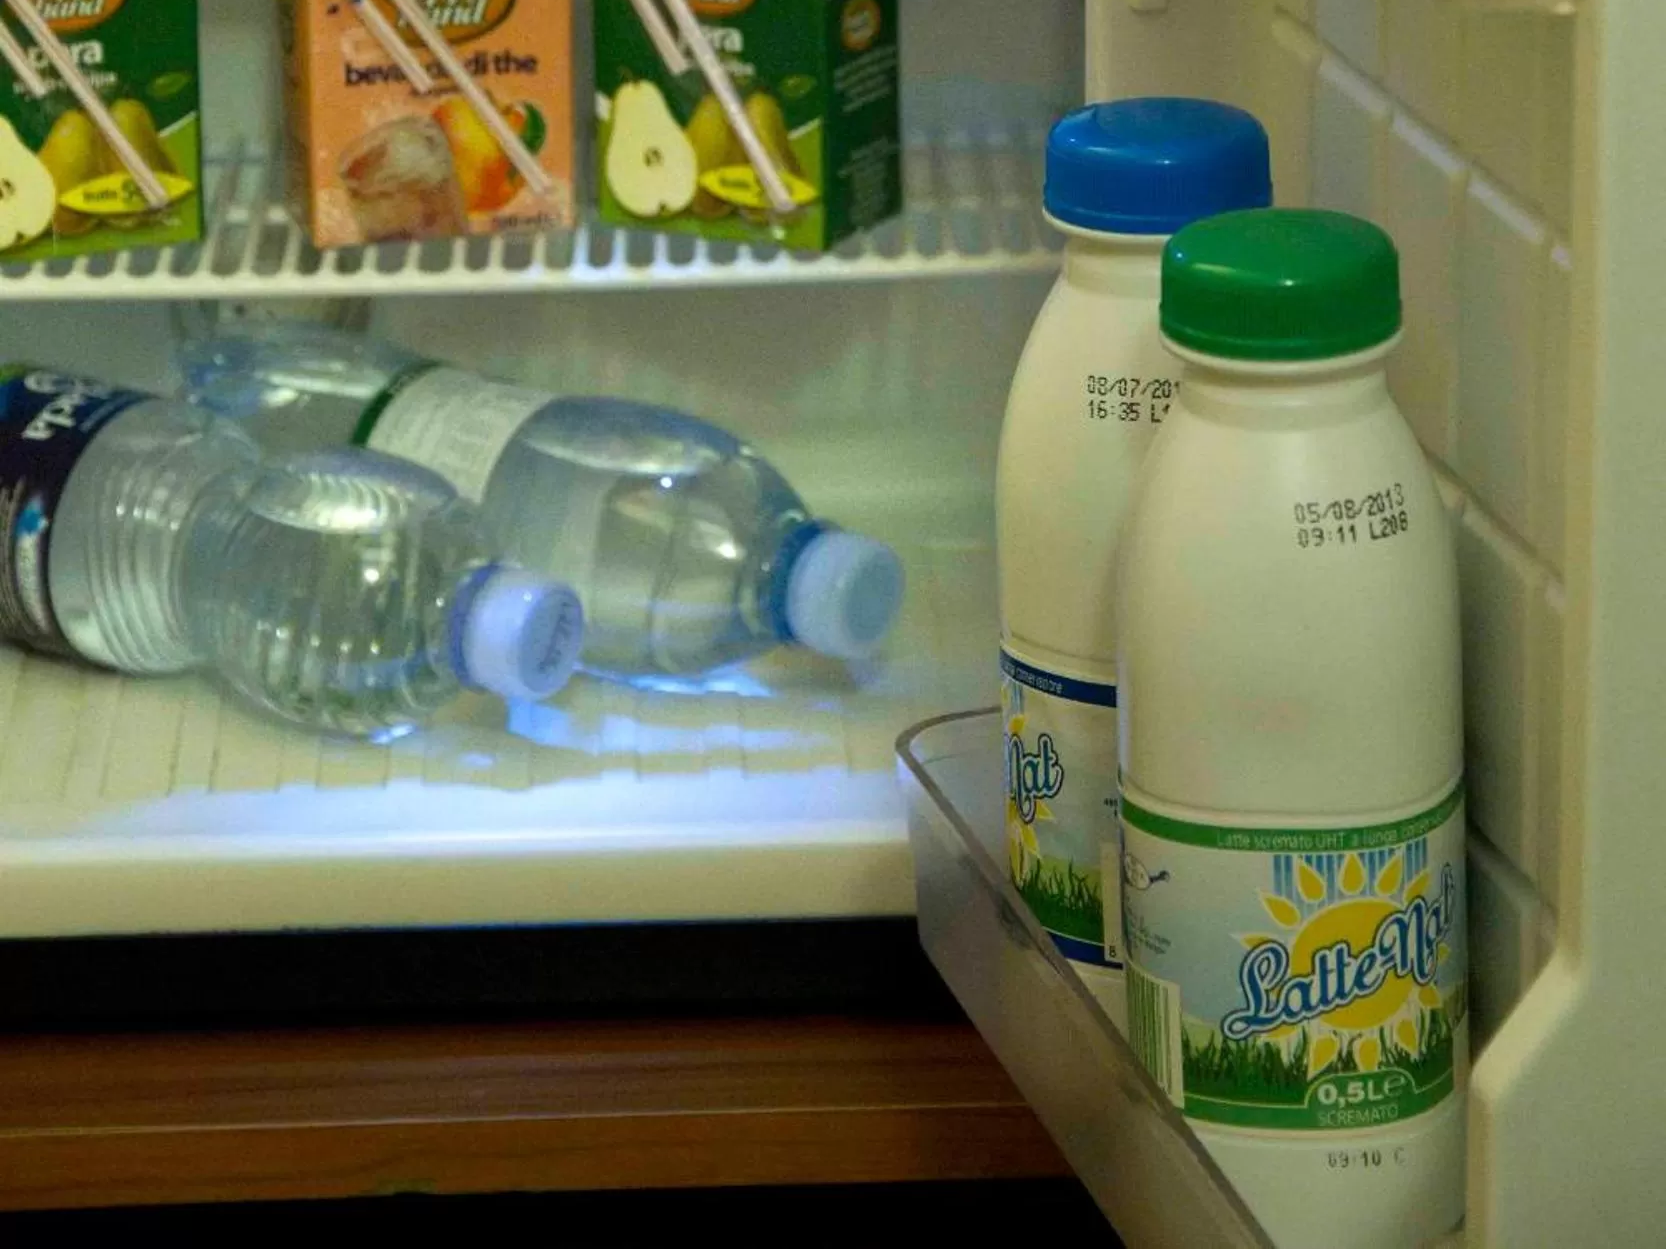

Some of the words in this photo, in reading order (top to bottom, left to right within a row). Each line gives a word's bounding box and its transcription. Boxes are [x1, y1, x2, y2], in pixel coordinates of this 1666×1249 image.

[493, 48, 538, 75] the
[1088, 399, 1141, 422] 16:35
[1293, 482, 1405, 524] 05/08/2013
[1316, 831, 1345, 849] UHT
[1318, 1102, 1400, 1127] SCREMATO
